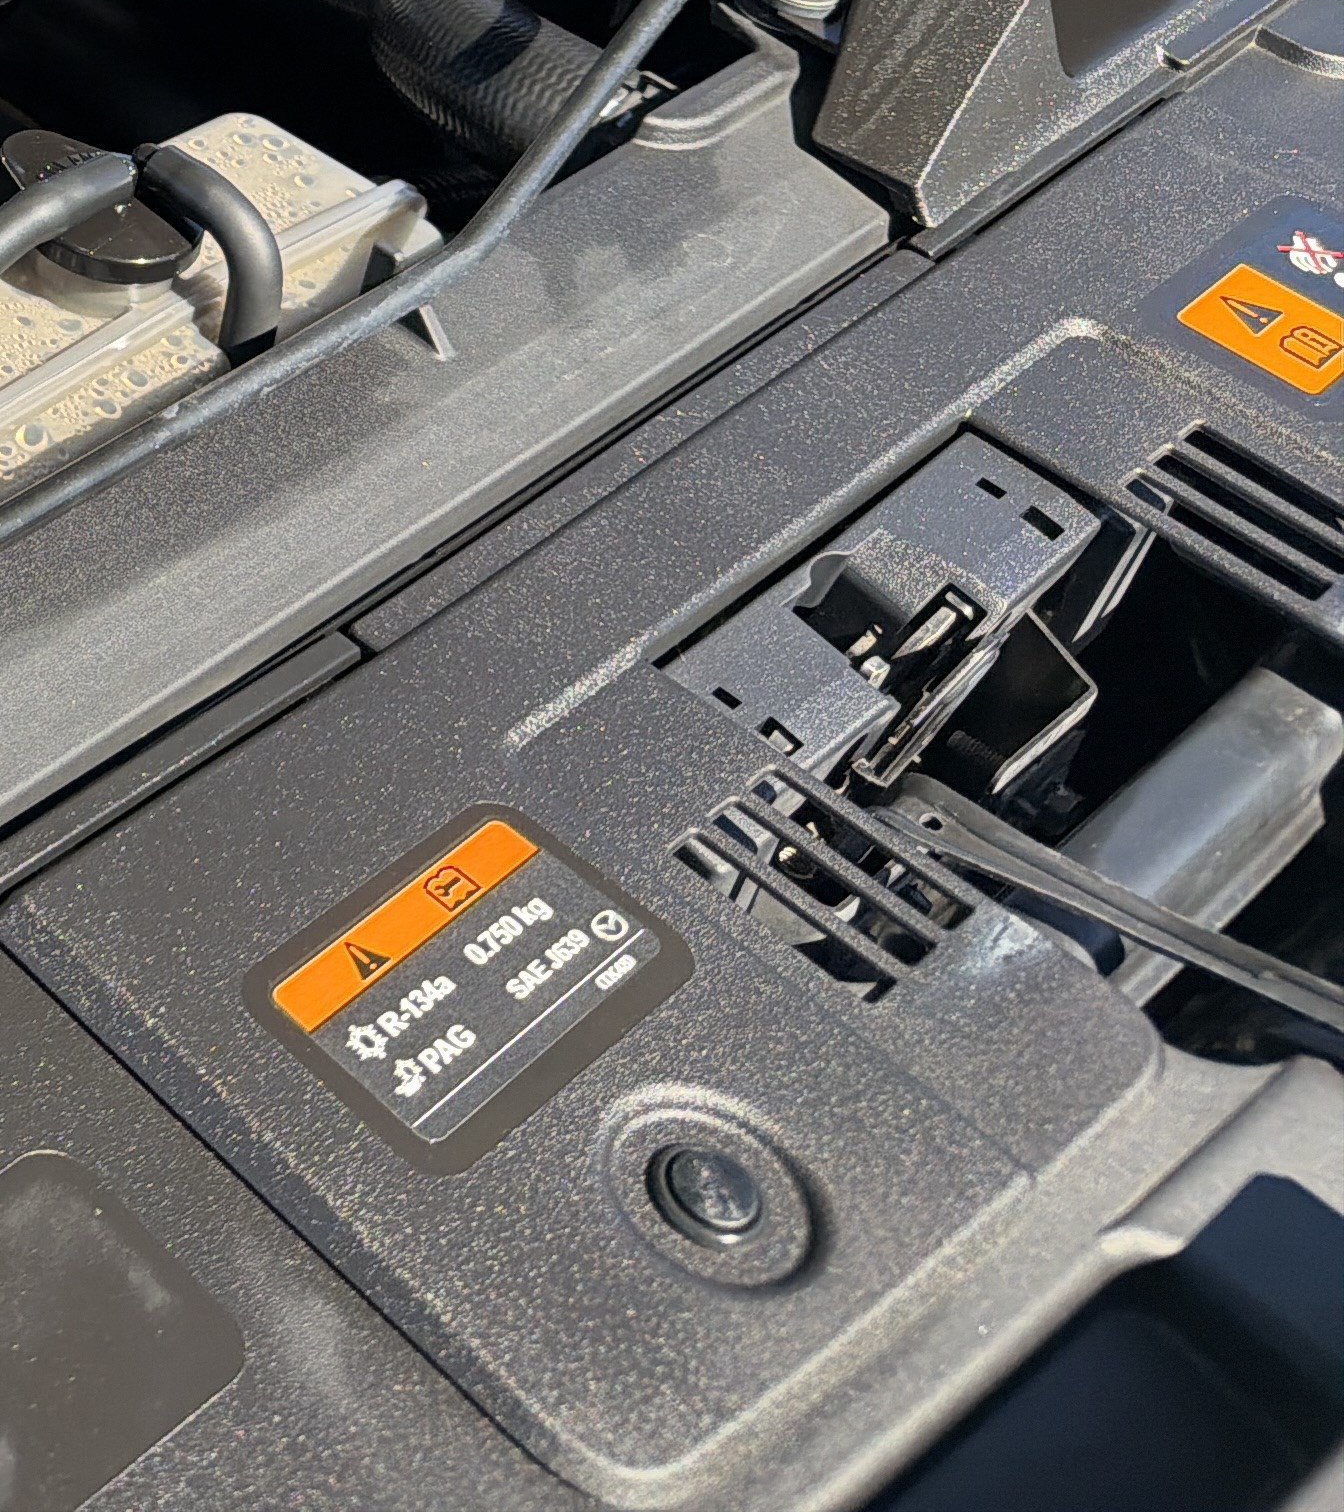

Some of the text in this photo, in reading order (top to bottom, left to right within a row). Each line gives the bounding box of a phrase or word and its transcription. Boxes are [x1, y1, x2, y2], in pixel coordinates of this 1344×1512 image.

[376, 897, 554, 1037] R-134a 0.750 kg
[416, 928, 590, 1074] PAG SAE J639
